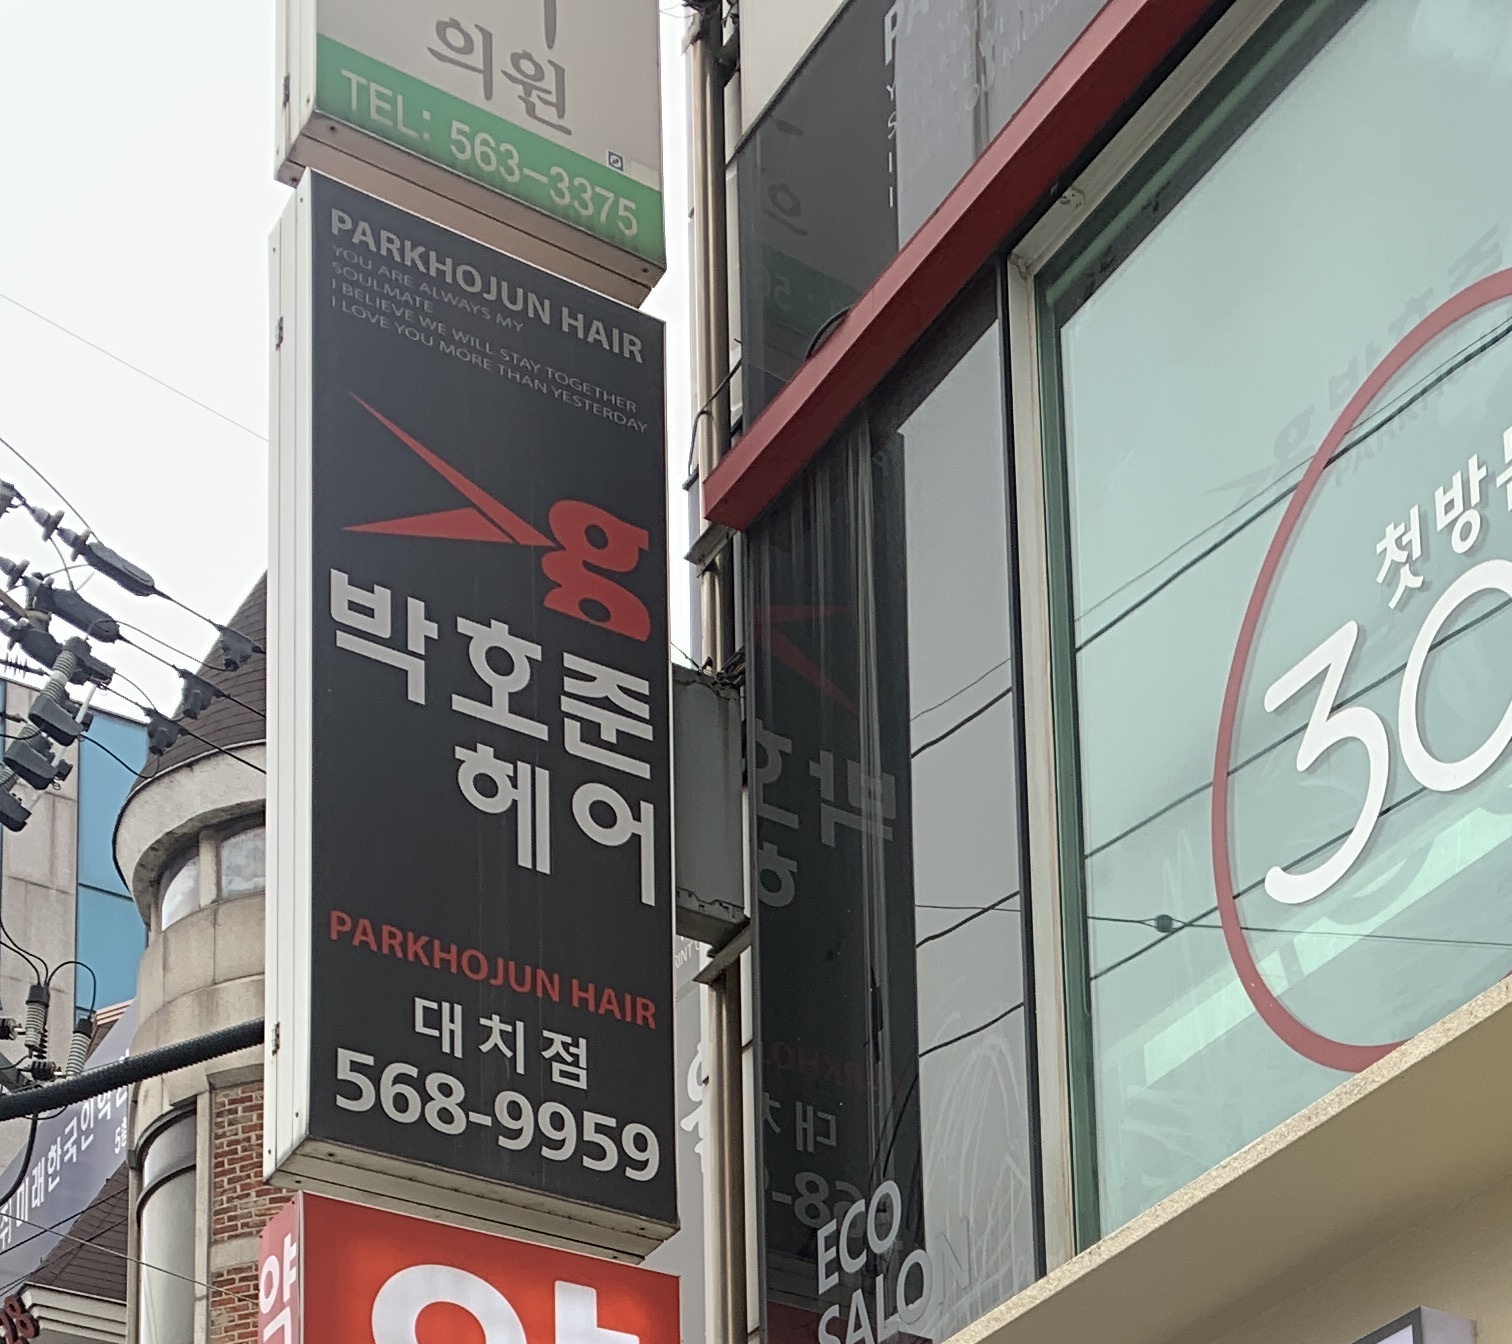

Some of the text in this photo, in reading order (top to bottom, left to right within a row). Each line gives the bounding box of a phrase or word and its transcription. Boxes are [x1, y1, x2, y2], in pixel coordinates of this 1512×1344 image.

[427, 15, 572, 137] 의원
[340, 67, 640, 239] TEL: 563-3375
[331, 208, 644, 364] PARKHOJUN HAIR
[331, 243, 526, 333] YOU ARE ALWAYS MY
[331, 262, 435, 314] SOULMATE
[341, 281, 415, 324] BELIEVE
[418, 314, 447, 337] WE
[451, 327, 494, 356] WILL
[499, 348, 542, 376] STAY
[545, 366, 638, 414] TOGETHER
[341, 298, 390, 331] LOVE
[394, 321, 434, 348] YOU
[438, 341, 494, 373] MORE
[496, 362, 548, 395] THAN
[551, 385, 649, 435] YESTERDAY
[330, 567, 654, 780] 박호준
[454, 742, 656, 907] 헤어
[329, 908, 657, 1031] PARKHOJUN HAIR
[412, 996, 589, 1094] 대치점
[334, 1046, 661, 1183] 568-9959
[816, 1177, 902, 1291] ECO
